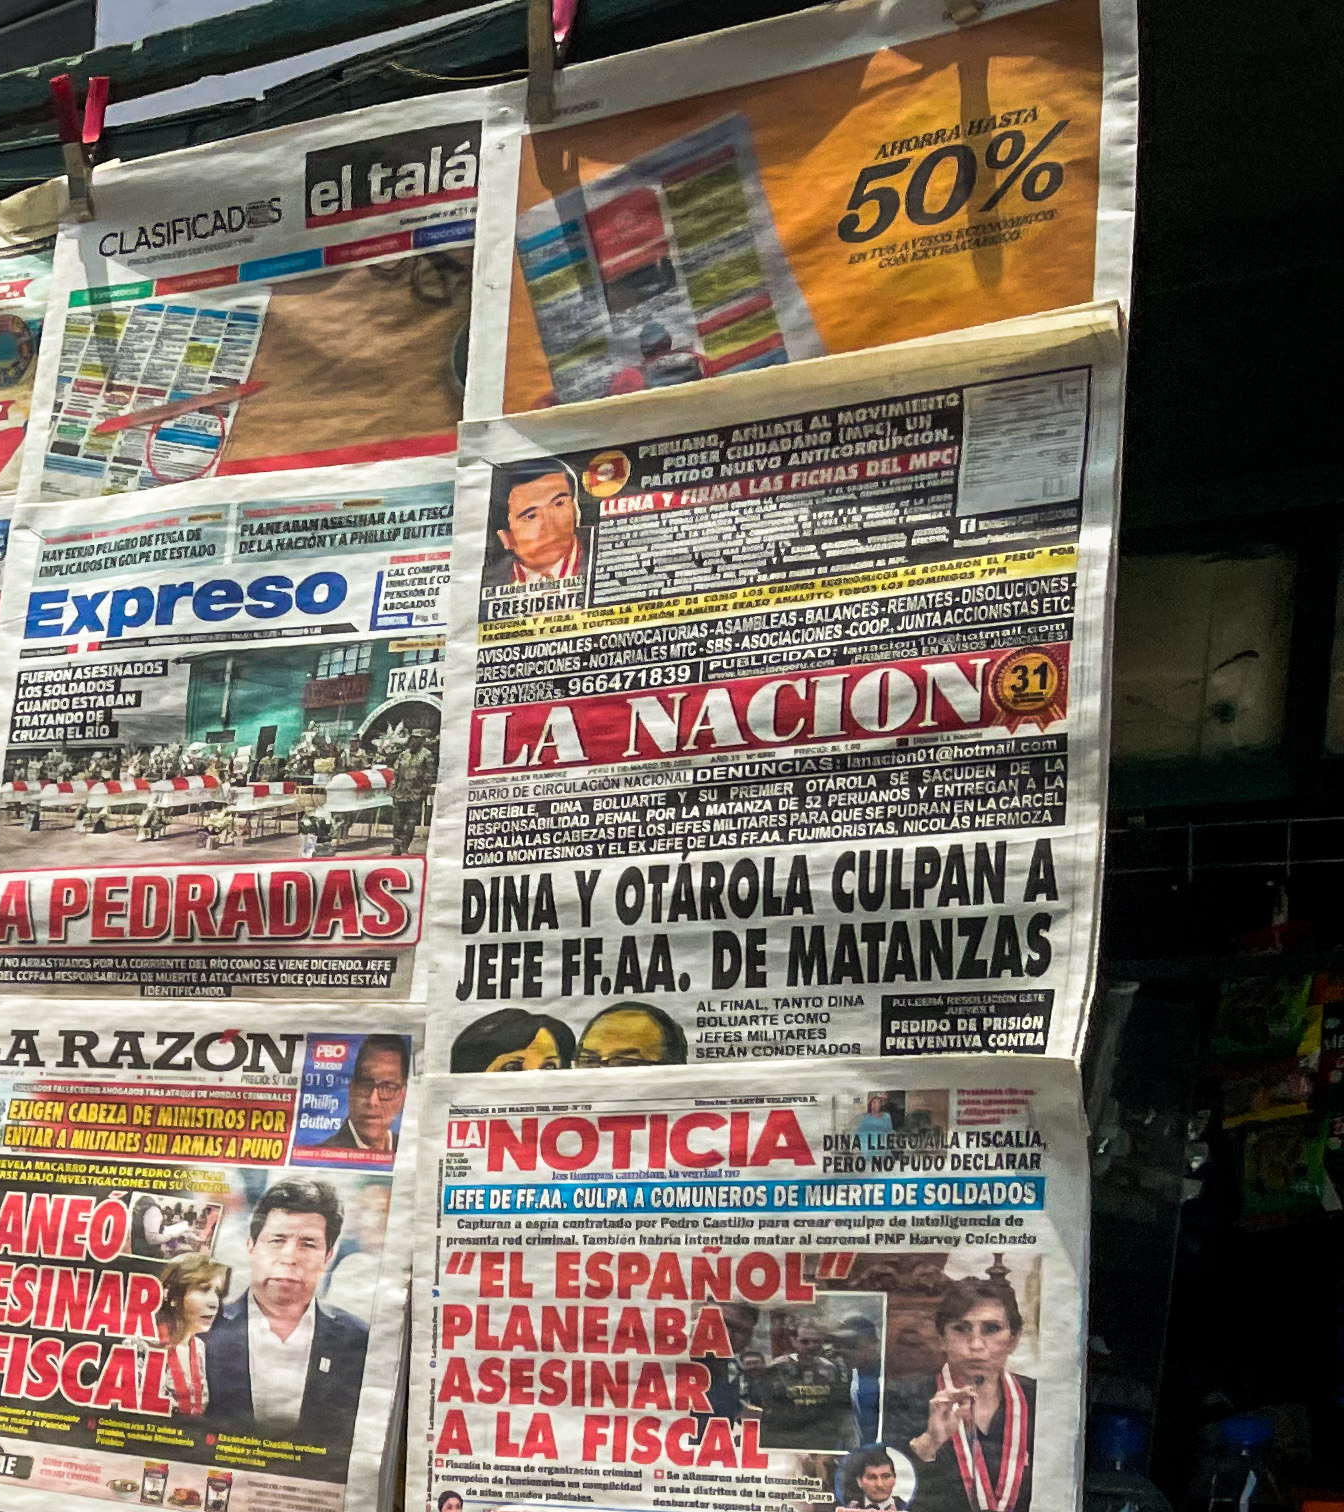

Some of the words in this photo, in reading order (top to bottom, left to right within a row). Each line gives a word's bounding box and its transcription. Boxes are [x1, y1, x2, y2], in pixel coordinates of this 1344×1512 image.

[875, 118, 963, 161] AHORRA
[966, 105, 1040, 139] HASTA
[310, 164, 353, 218] el
[836, 118, 1071, 244] 50%
[23, 570, 348, 639] Expreso
[18, 685, 42, 699] LOS
[43, 680, 115, 697] SOLDADOS
[20, 668, 72, 685] FUERON
[73, 662, 163, 680] ASESINADOS
[567, 665, 691, 696] 966471839
[1010, 661, 1050, 694] 31
[14, 713, 84, 728] TRATANDO
[86, 710, 105, 723] DE
[16, 698, 70, 713] CUANDO
[71, 693, 136, 709] ESTABAN
[473, 706, 589, 773] LA
[622, 656, 993, 758] NACION
[12, 728, 63, 742] CRUZAR
[66, 727, 82, 738] EL
[468, 787, 509, 802] DIARIO
[512, 785, 530, 799] DE
[532, 775, 620, 797] CIRCULACIÓN
[623, 771, 691, 789] NACIONAL
[462, 872, 559, 935] DINA
[574, 868, 602, 929] Y
[615, 850, 814, 925] OTÁROLA
[831, 840, 1008, 914] CULPAN
[1023, 838, 1059, 902] A
[48, 867, 412, 942] PEDRADAS
[455, 941, 544, 1002] JEFE
[561, 933, 691, 997] FF.AA.
[711, 927, 767, 990] DE
[786, 912, 1053, 987] MATANZAS
[885, 1034, 983, 1051] PREVENTIVA
[987, 1031, 1044, 1047] CONTRA
[890, 1017, 951, 1035] PEDIDO
[956, 1017, 977, 1032] DE
[982, 1013, 1044, 1031] PRISIÓN
[54, 1027, 304, 1075] RAZÓN
[9, 1100, 63, 1122] EXIGEN
[68, 1103, 127, 1125] CABEZA
[132, 1106, 153, 1126] DE
[157, 1108, 246, 1131] MINISTROS
[251, 1110, 287, 1132] POR
[4, 1126, 54, 1148] ENVIAR
[56, 1129, 67, 1148] A
[70, 1131, 140, 1153] MILITARES
[143, 1133, 167, 1154] SIN
[170, 1135, 221, 1157] ARMAS
[225, 1138, 238, 1157] A
[240, 1139, 284, 1160] PUNO
[451, 1122, 482, 1148] LA
[487, 1109, 816, 1172] NOTICIA
[823, 1154, 866, 1174] PERO
[871, 1154, 895, 1172] NO
[899, 1153, 945, 1172] PUDO
[950, 1151, 1042, 1171] DECLARAR
[447, 1189, 485, 1210] JEFE
[489, 1189, 511, 1209] DE
[516, 1189, 567, 1210] FF.AA.
[573, 1187, 628, 1208] CULPA
[634, 1188, 646, 1208] A
[651, 1185, 768, 1208] COMUNEROS
[773, 1185, 799, 1207] DE
[805, 1183, 885, 1206] MUERTE
[891, 1183, 918, 1206] DE
[923, 1181, 1037, 1205] SOLDADOS
[442, 1304, 734, 1358] PLANEABA
[437, 1357, 713, 1414] ASESINAR
[436, 1409, 473, 1456] A
[495, 1411, 558, 1460] LA
[582, 1414, 769, 1469] FISCAL
